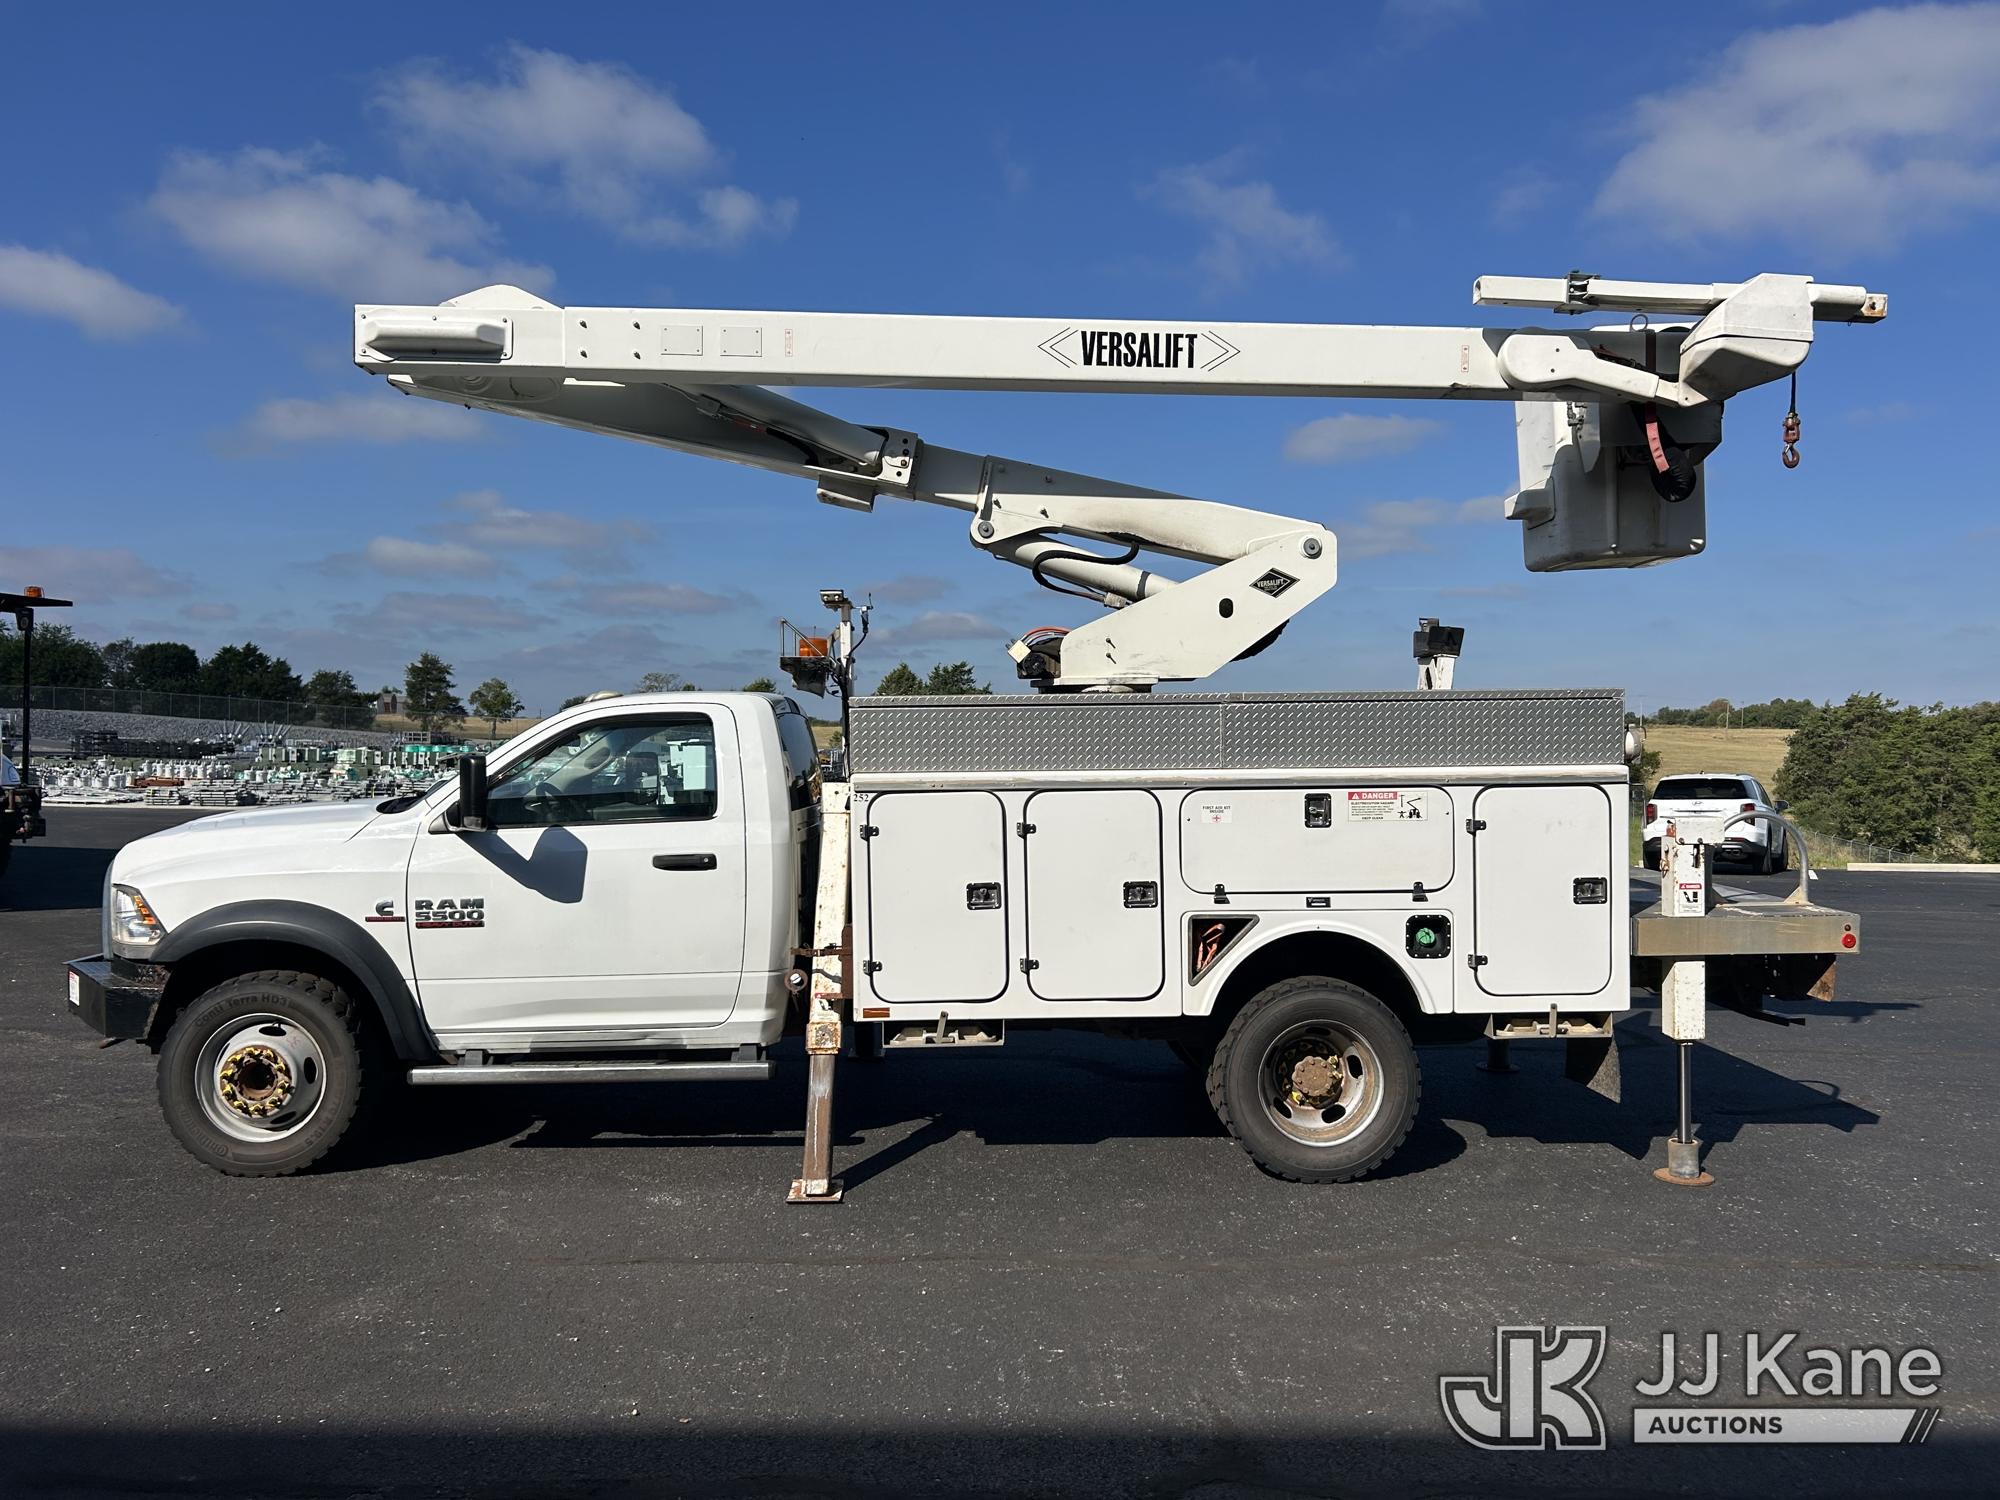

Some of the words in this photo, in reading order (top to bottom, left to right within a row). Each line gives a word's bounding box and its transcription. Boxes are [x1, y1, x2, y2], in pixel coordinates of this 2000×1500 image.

[1081, 331, 1197, 368] VERSALIFT
[1257, 579, 1284, 588] VERSALIFT
[415, 899, 484, 910] RAM
[415, 910, 484, 921] 5500
